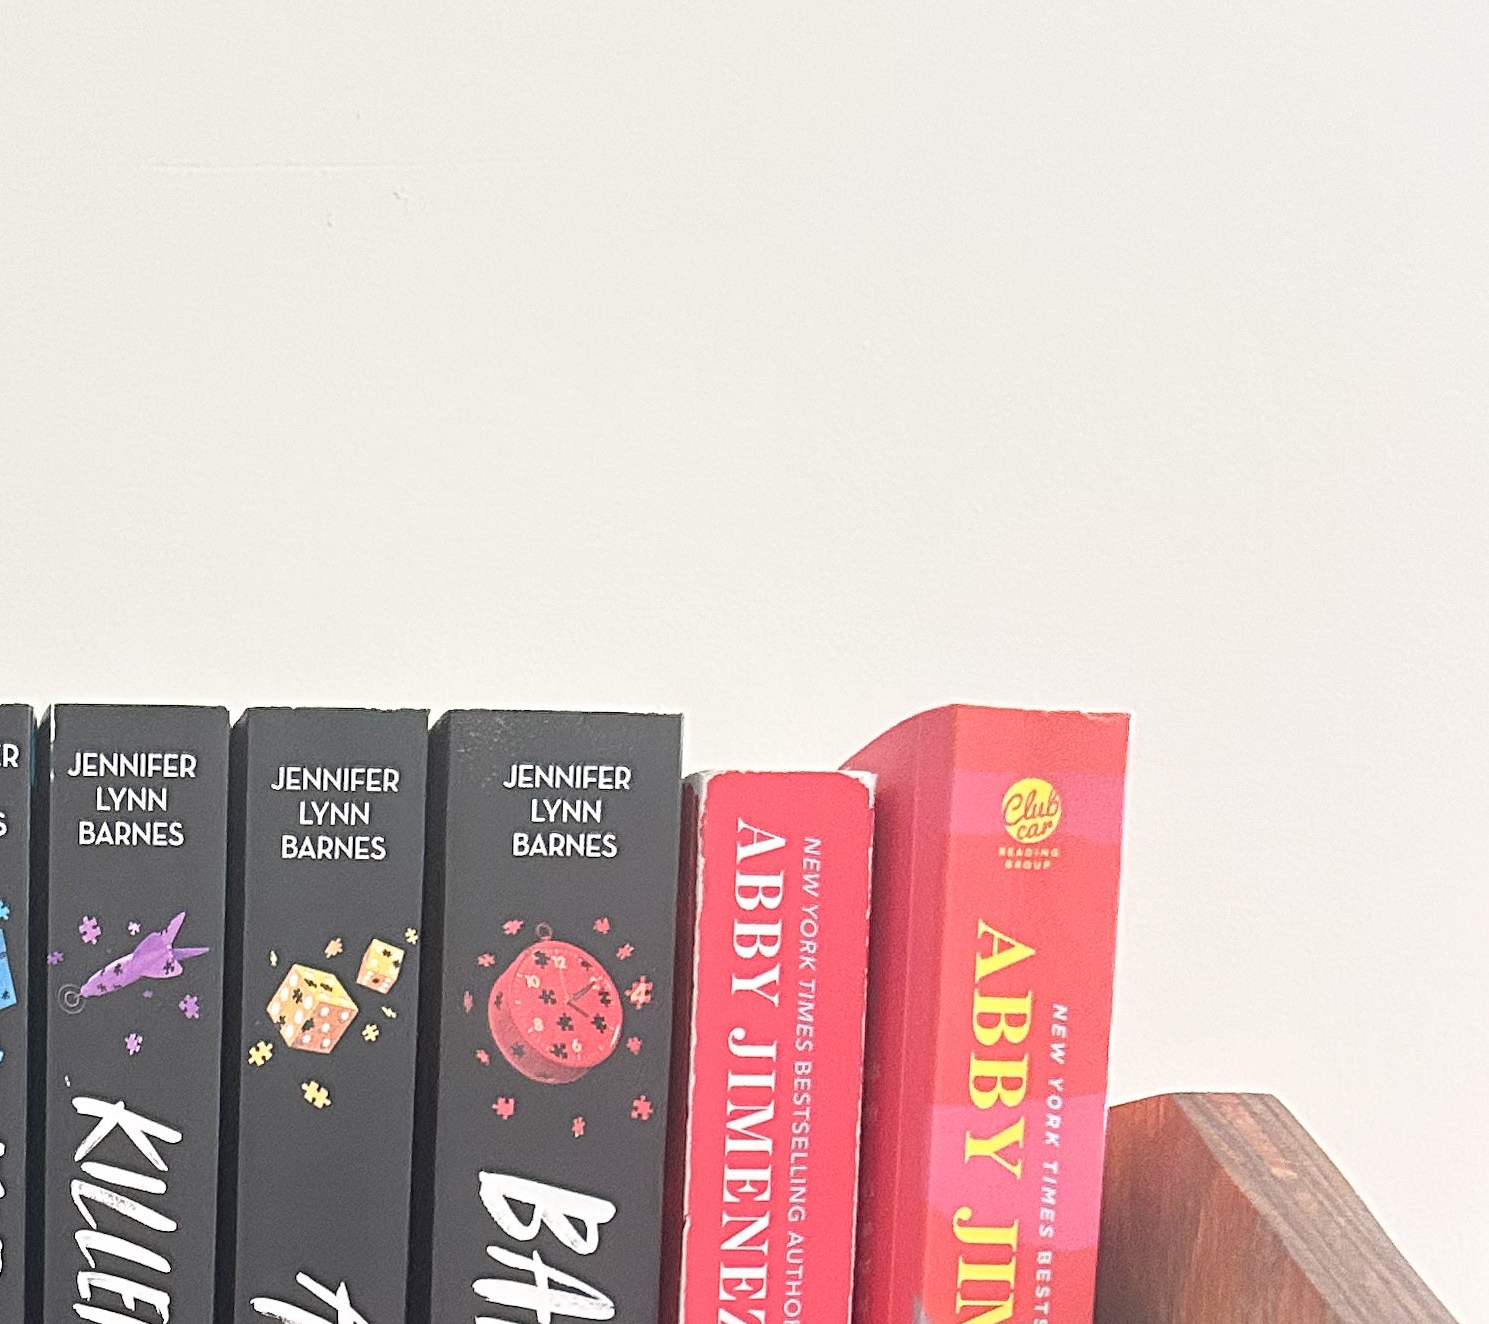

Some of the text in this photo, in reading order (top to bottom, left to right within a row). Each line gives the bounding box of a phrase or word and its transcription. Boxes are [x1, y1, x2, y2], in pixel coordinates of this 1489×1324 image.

[67, 752, 197, 779] JENNIFER
[270, 766, 400, 793] JENNIFER
[503, 764, 631, 791] JENNIFER
[95, 787, 168, 812] LYNN
[299, 801, 370, 826] LYNN
[530, 799, 602, 824] LYNN
[1004, 789, 1058, 826] Club
[78, 821, 184, 847] BARNES
[281, 835, 387, 861] BARNES
[512, 832, 618, 858] BARNES
[802, 836, 821, 896] NEW
[730, 818, 787, 1008] ABBY
[800, 900, 817, 969] YORK
[796, 975, 816, 1053] TIMES
[964, 918, 1036, 1180] ABBY
[1051, 1003, 1068, 1066] NEW
[1045, 1078, 1064, 1148] YORK
[789, 1058, 812, 1221] BESTSELLING
[1038, 1160, 1059, 1239] TIMES
